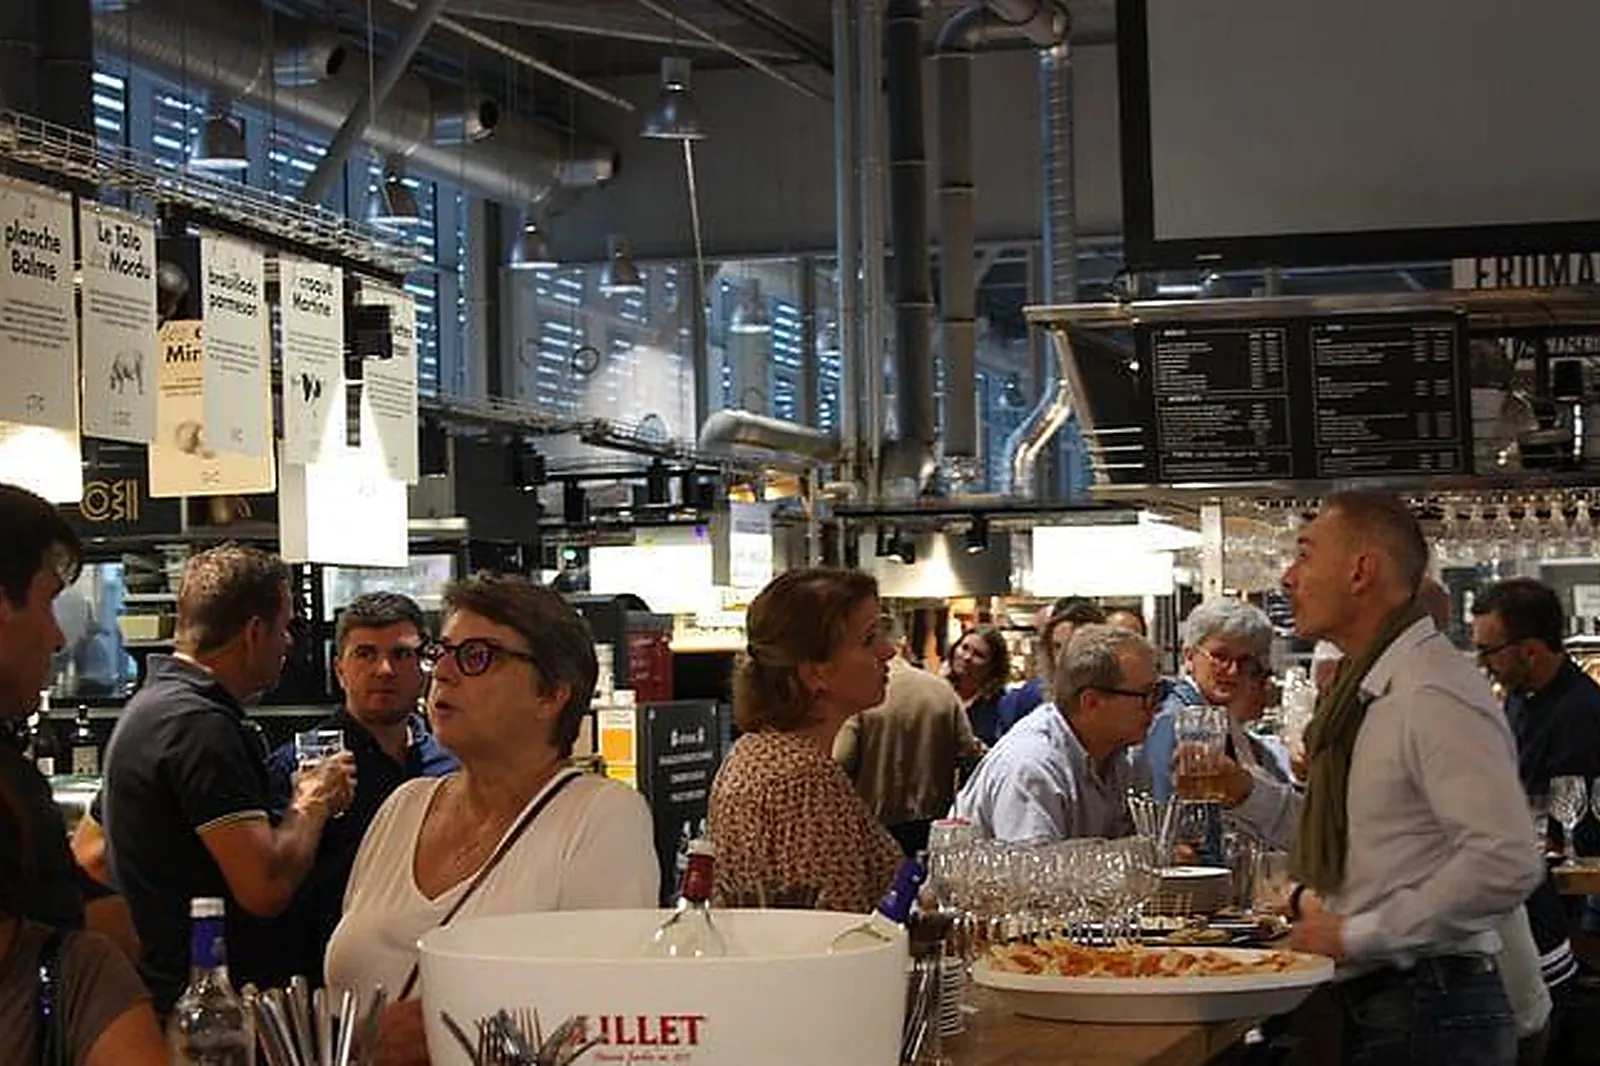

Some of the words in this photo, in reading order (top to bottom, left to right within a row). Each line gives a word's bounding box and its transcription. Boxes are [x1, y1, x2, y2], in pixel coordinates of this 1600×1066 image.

[5, 218, 61, 254] planche
[97, 219, 112, 245] Le
[12, 249, 57, 281] Balme
